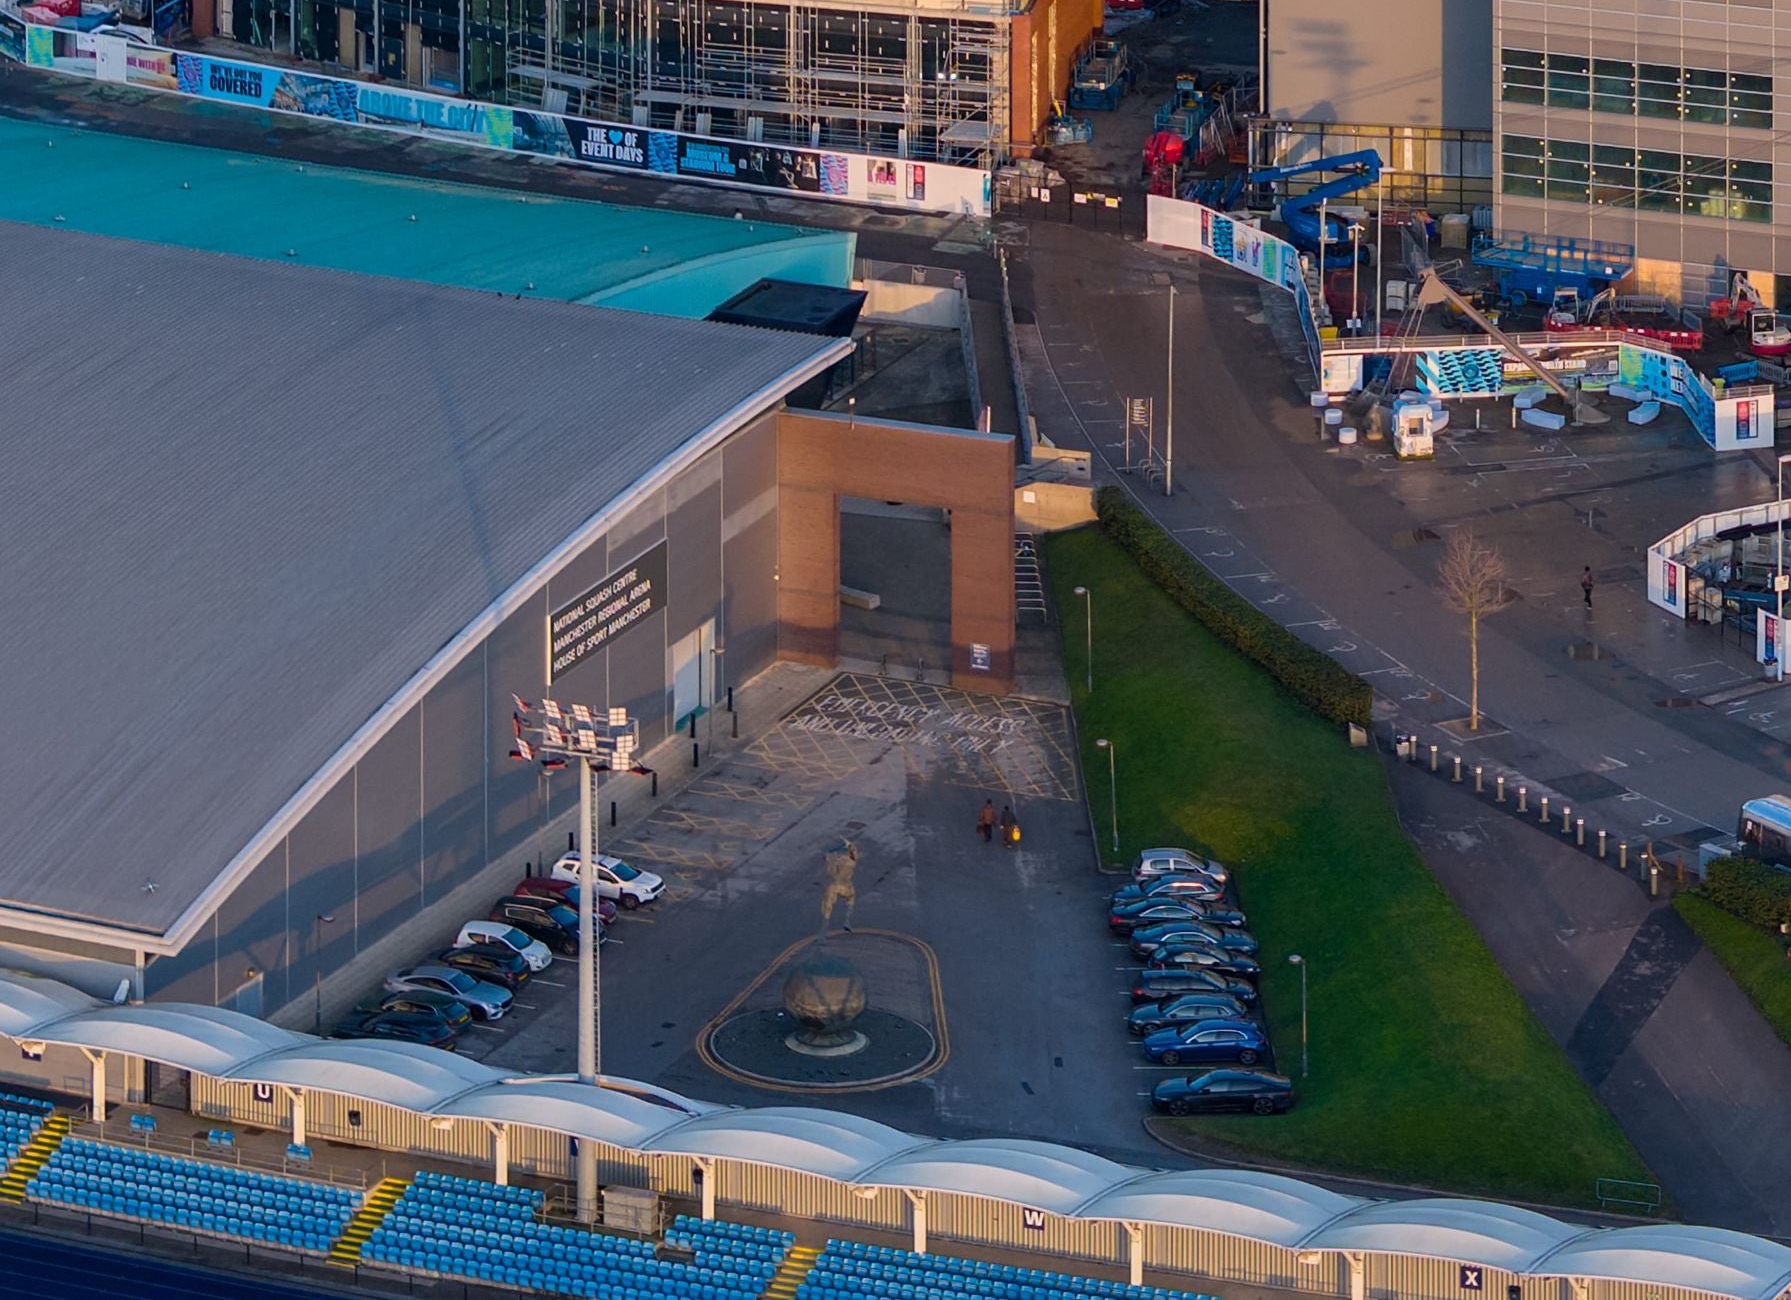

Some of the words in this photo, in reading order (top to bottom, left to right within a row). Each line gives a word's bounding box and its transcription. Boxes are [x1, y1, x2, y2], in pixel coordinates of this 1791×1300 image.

[209, 76, 262, 98] COVERED
[359, 89, 412, 122] ABOVE
[415, 97, 444, 128] THE
[587, 126, 608, 142] THE
[625, 132, 639, 147] OF
[581, 140, 615, 159] EVENT
[616, 145, 644, 162] DAYS
[553, 604, 585, 634] NATIONAL
[586, 585, 612, 612] SQUASH
[612, 567, 638, 594] CENTRE
[553, 616, 597, 653] MANCHESTER
[598, 594, 629, 623] REGIONAL
[630, 579, 652, 602] ARENA
[553, 649, 576, 673] HOUSE
[577, 643, 586, 656] OF
[586, 626, 609, 650] SPORT
[609, 598, 652, 635] MANCHESTER
[815, 695, 941, 723] EMERGENCY
[941, 710, 1028, 735] ACCESS
[257, 1083, 271, 1099] U
[1024, 1209, 1045, 1226] W
[1465, 1270, 1479, 1286] X
